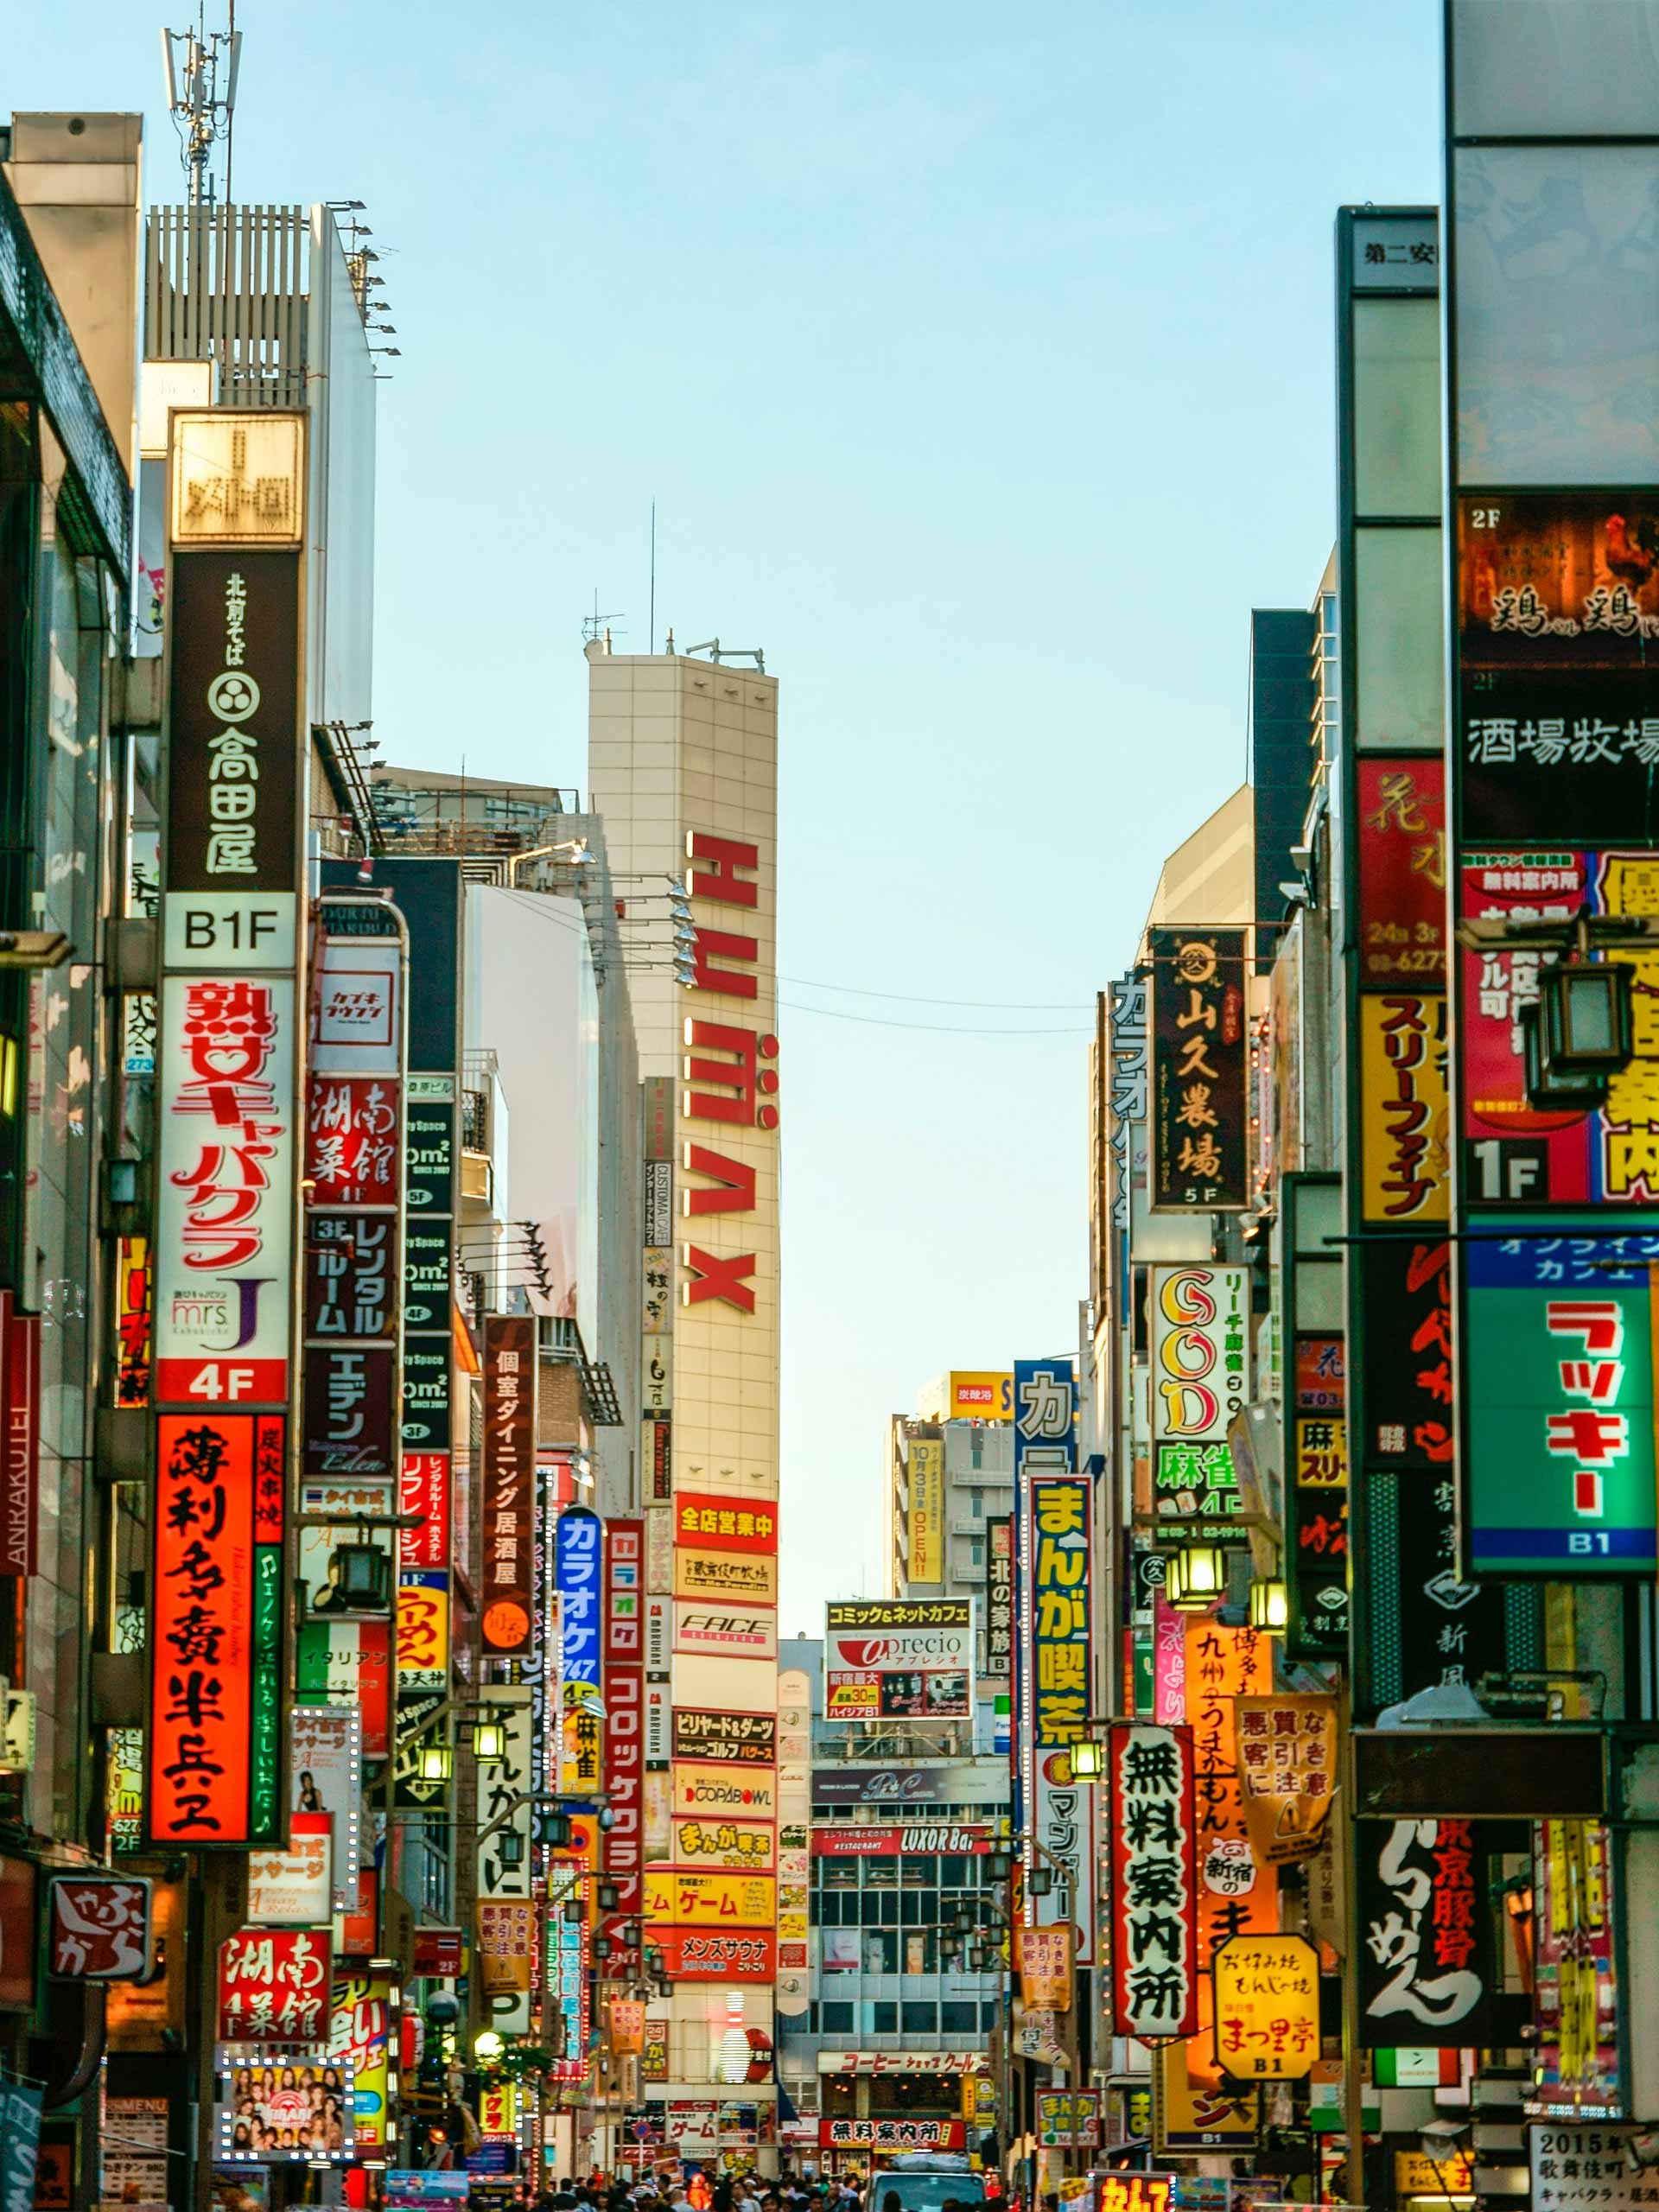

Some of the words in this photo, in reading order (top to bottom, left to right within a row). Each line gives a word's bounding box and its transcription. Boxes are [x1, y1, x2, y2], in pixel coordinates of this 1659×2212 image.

[1471, 508, 1501, 529] 2F
[225, 573, 246, 666] 北前そば
[184, 910, 279, 950] B1F
[332, 992, 380, 1006] カブキ
[325, 1006, 386, 1020] ラウンジ
[685, 830, 779, 1314] HUMAX
[1175, 988, 1220, 1177] 山久農場
[309, 1084, 396, 1135] 湖南
[1380, 997, 1437, 1217] スリーファイブ
[169, 982, 287, 1269] 熟女キャバクラ
[1472, 1139, 1540, 1198] 1F
[656, 1164, 669, 1216] CUSTOMA
[1185, 1188, 1217, 1202] 5F
[318, 1221, 348, 1238] 3F
[353, 1218, 386, 1334] レンタル
[1536, 1260, 1634, 1280] カフェ
[315, 1248, 349, 1332] ルーム
[407, 1309, 425, 1321] 4F
[1224, 1274, 1244, 1372] リーチ麻雀
[1160, 1269, 1218, 1435] GOD
[188, 1363, 255, 1401] 4F
[327, 1353, 367, 1440] エデン
[1547, 1300, 1630, 1517] ラッキー
[406, 1427, 424, 1437] 3F
[257, 1427, 283, 1527] 炭火串焼
[493, 1351, 519, 1585] 個室ダイニング居酒屋
[1156, 1443, 1238, 1490] 麻雀
[7, 1407, 29, 1567] ANRAKUTEI
[401, 1455, 423, 1566] リフレシュ
[680, 1507, 773, 1538] 全店営業中
[1569, 1533, 1610, 1554] B1
[563, 1518, 596, 1656] カラオケ
[613, 1536, 636, 1644] カラオケ
[829, 1605, 969, 1624] コミック&ネットカフェ
[989, 1558, 1011, 1654] 北の家族
[1038, 1486, 1087, 1745] まんが喫茶
[680, 1614, 772, 1635] FACE
[650, 1619, 663, 1666] MARUHAN
[303, 1650, 389, 1667] イタリアン
[563, 1658, 596, 1681] 747
[829, 1705, 880, 1718] ハイジアB1
[1242, 1711, 1325, 1736] 悪質な
[650, 1707, 663, 1754] MARUHAN
[677, 1713, 774, 1740] ビリヤード&ダーツ
[576, 1713, 597, 1779] 麻雀
[707, 1742, 740, 1760] ゴルフ
[1244, 1742, 1326, 1767] 客引き
[1246, 1771, 1328, 1797] に注意
[115, 1836, 141, 1852] 2F
[679, 1823, 771, 1855] まんが喫茶
[900, 1828, 950, 1852] LUXOR
[1124, 1741, 1185, 2020] 無料案内所
[1206, 1857, 1253, 1883] 新宿
[1222, 1881, 1238, 1894] の
[480, 1906, 528, 1921] 悪質な
[678, 1890, 738, 1917] ゲーム
[481, 1923, 527, 1938] 客引き
[226, 1933, 326, 1989] 湖南
[482, 1942, 528, 1955] に注意
[681, 1938, 767, 1959] メンズサウナ
[1023, 1949, 1065, 1962] 客引き
[1023, 1964, 1066, 1978] に注意
[1223, 1954, 1300, 1971] お好み焼
[246, 1990, 324, 2041] 菜館
[1221, 2017, 1314, 2053] まつ里亭
[841, 2053, 900, 2073] コーヒー
[944, 2052, 973, 2070] クール
[1254, 2058, 1283, 2073] B1
[125, 2101, 167, 2112] MENU
[671, 2122, 716, 2139] ゲーム
[831, 2120, 941, 2143] 無料案内所
[1540, 2133, 1624, 2154] 2015年
